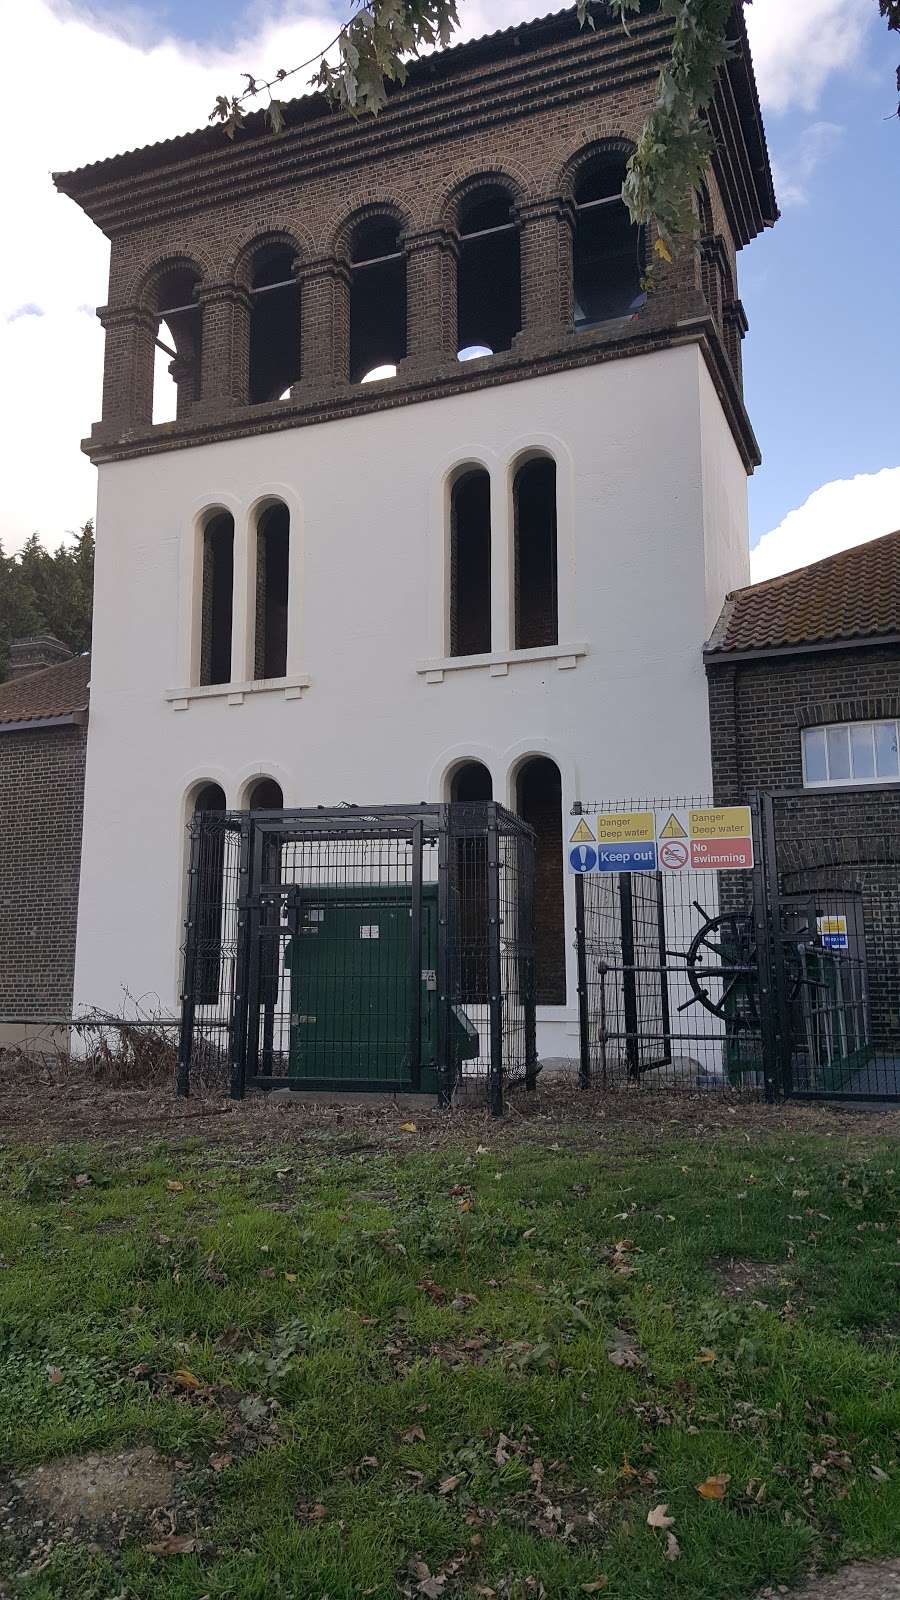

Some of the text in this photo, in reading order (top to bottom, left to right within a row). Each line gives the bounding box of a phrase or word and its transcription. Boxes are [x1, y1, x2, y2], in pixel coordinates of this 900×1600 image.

[599, 818, 631, 828] Danger
[691, 813, 725, 824] Danger
[600, 828, 649, 839] Deep water
[692, 824, 745, 835] Deep water
[693, 843, 708, 852] No
[601, 851, 653, 864] Keep out
[693, 852, 746, 864] swimming
